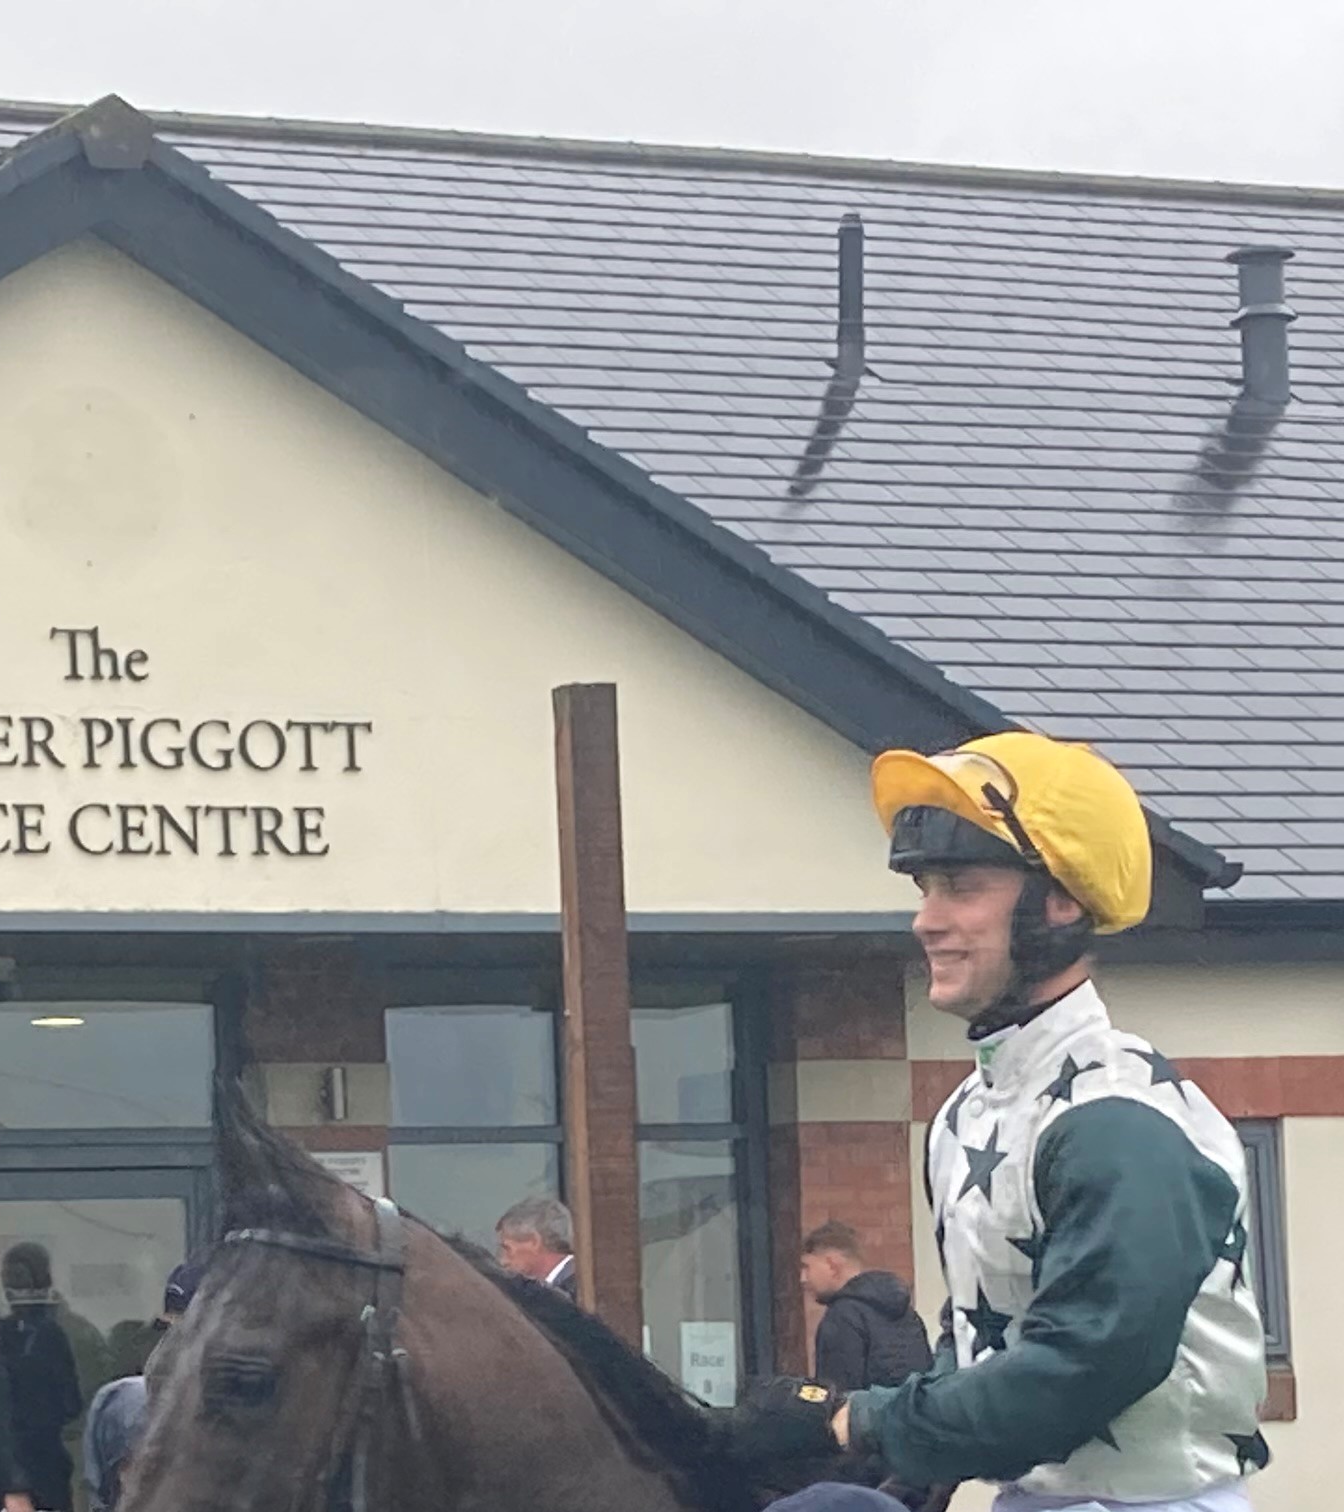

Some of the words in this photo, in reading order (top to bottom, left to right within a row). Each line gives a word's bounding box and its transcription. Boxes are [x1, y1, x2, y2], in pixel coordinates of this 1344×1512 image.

[49, 625, 150, 683] The
[80, 716, 374, 773] PIGGOTT
[67, 802, 331, 857] CENTRE
